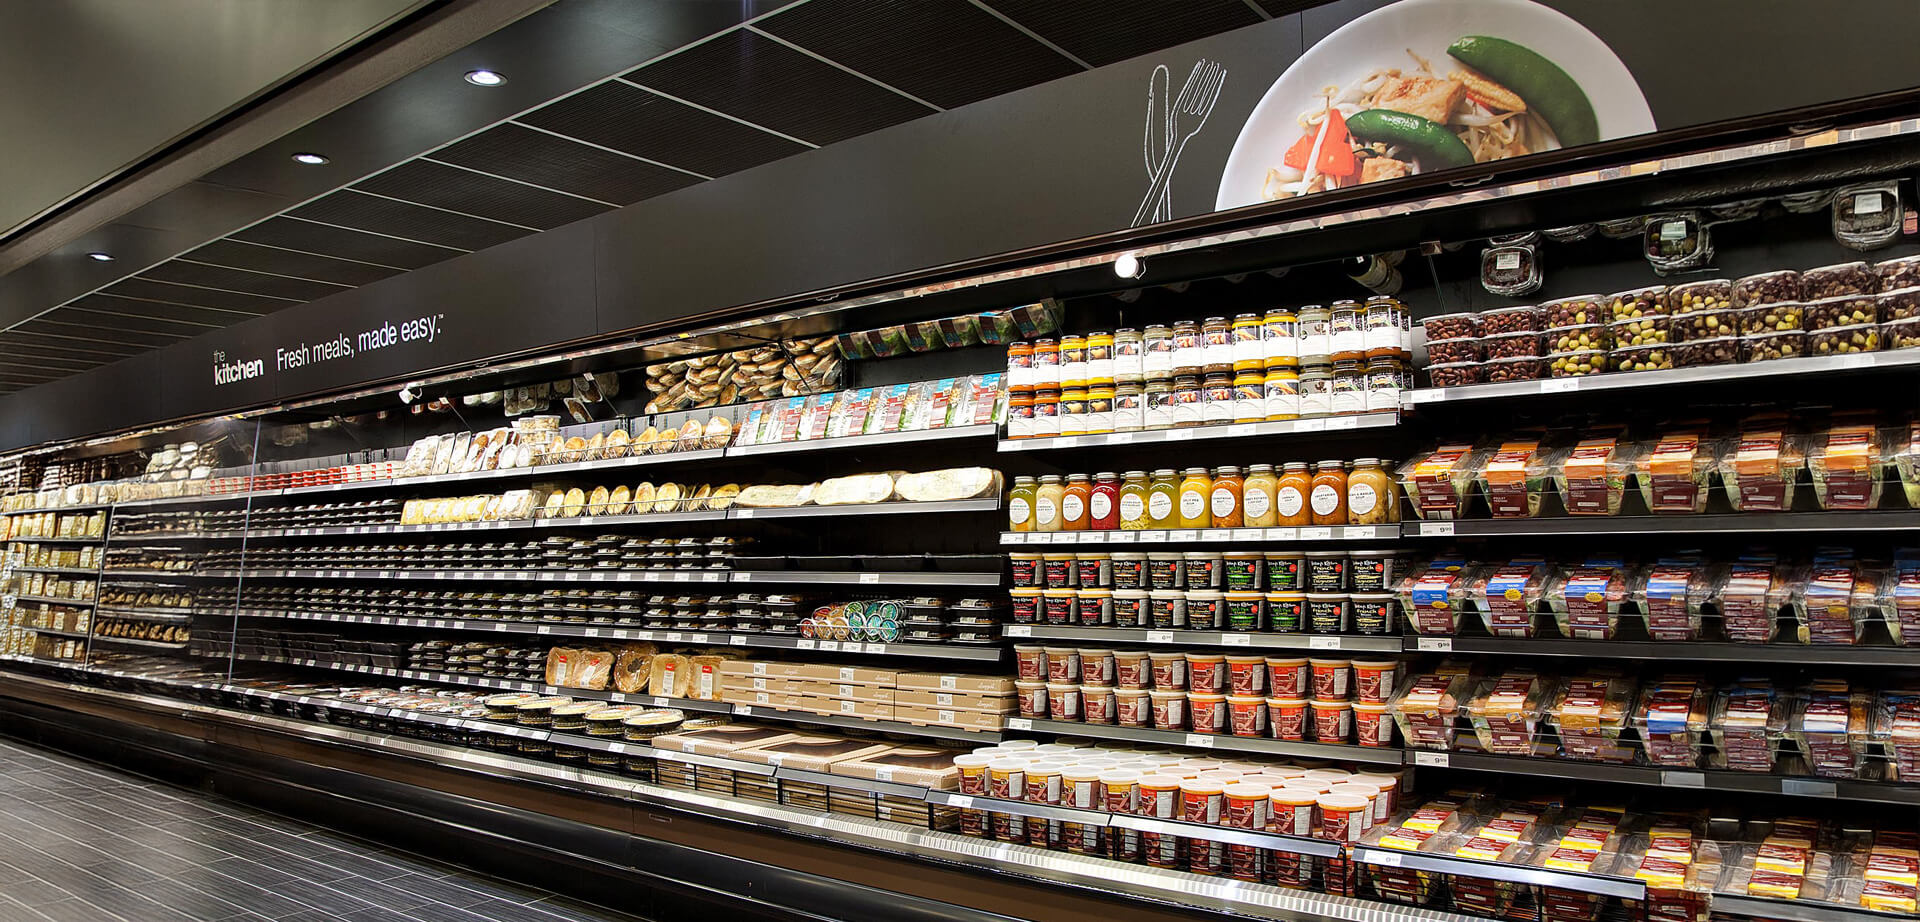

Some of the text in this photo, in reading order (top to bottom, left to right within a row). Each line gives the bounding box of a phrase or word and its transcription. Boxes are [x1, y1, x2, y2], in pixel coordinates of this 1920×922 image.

[213, 350, 264, 385] the kitchen
[277, 343, 310, 372] Fresh
[312, 333, 355, 362] meals,
[358, 320, 398, 352] made
